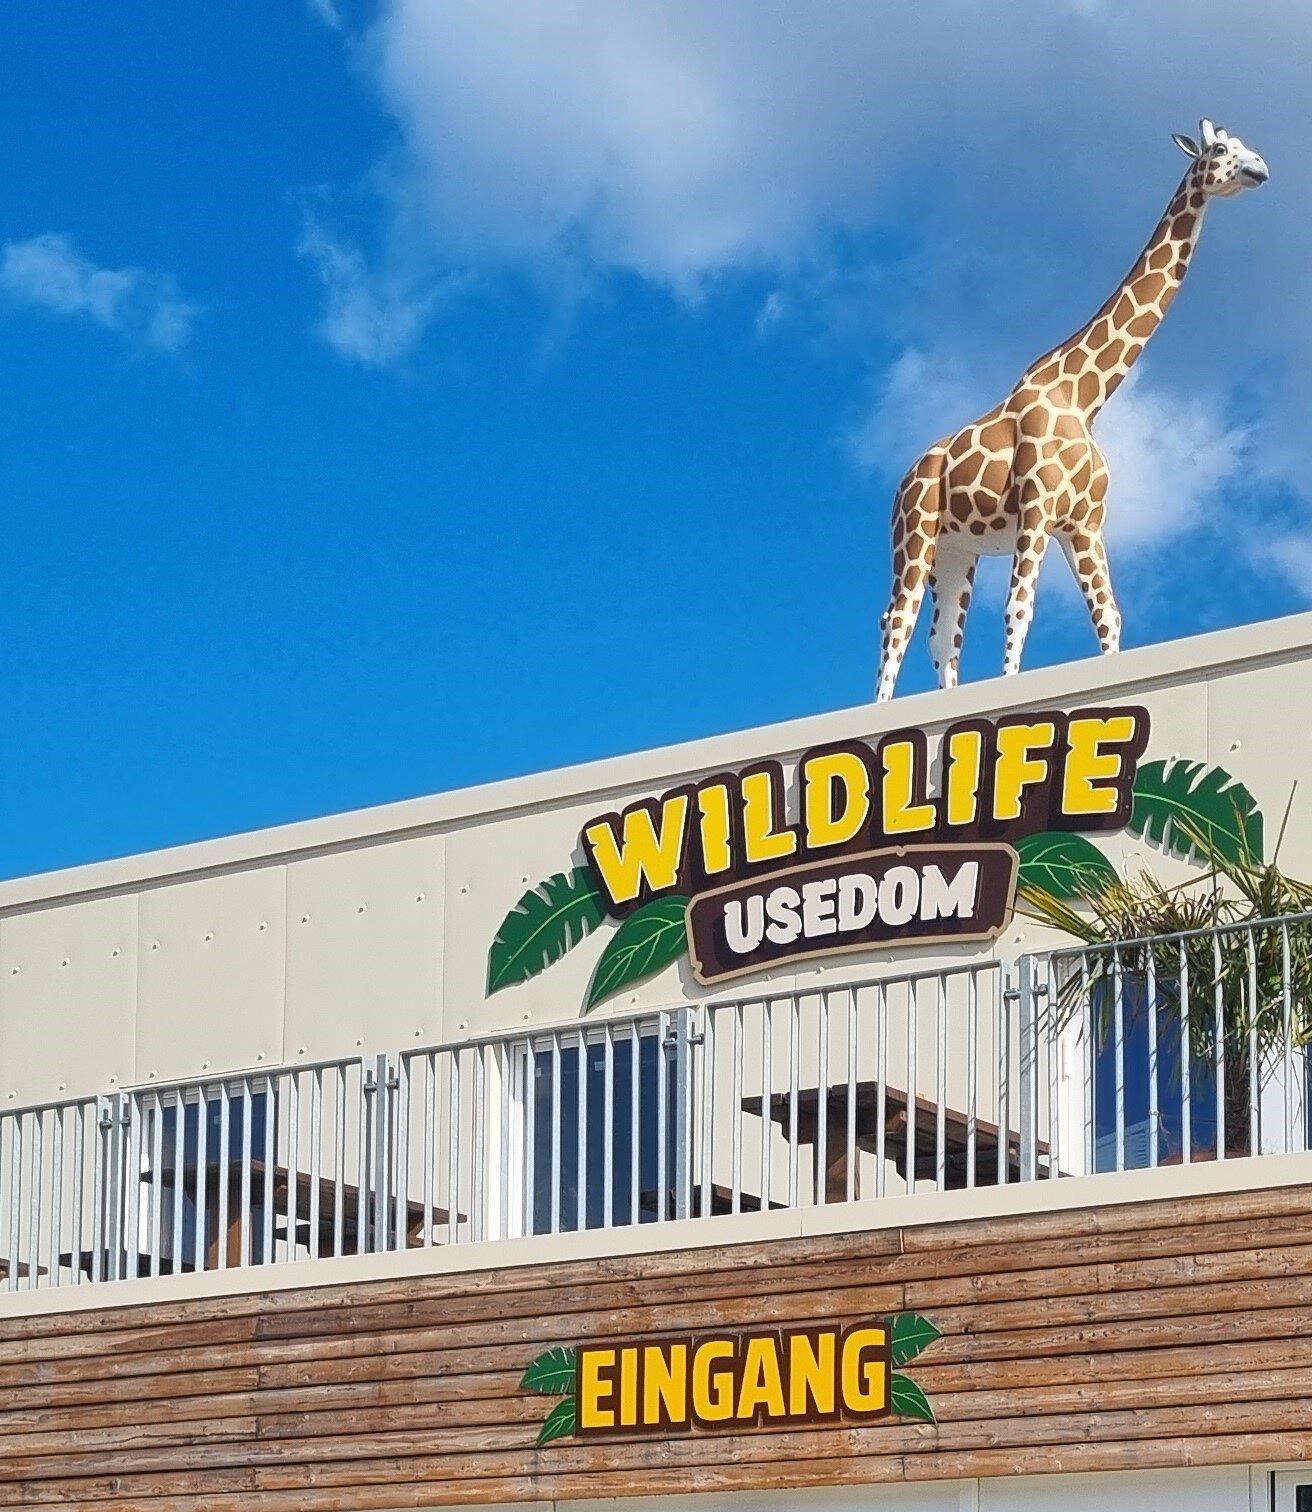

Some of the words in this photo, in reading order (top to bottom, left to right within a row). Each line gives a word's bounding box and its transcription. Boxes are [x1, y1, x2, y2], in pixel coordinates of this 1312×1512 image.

[586, 716, 1136, 904] WILDLIFE
[724, 861, 979, 954] USEDOM
[581, 1328, 886, 1429] EINGANG
